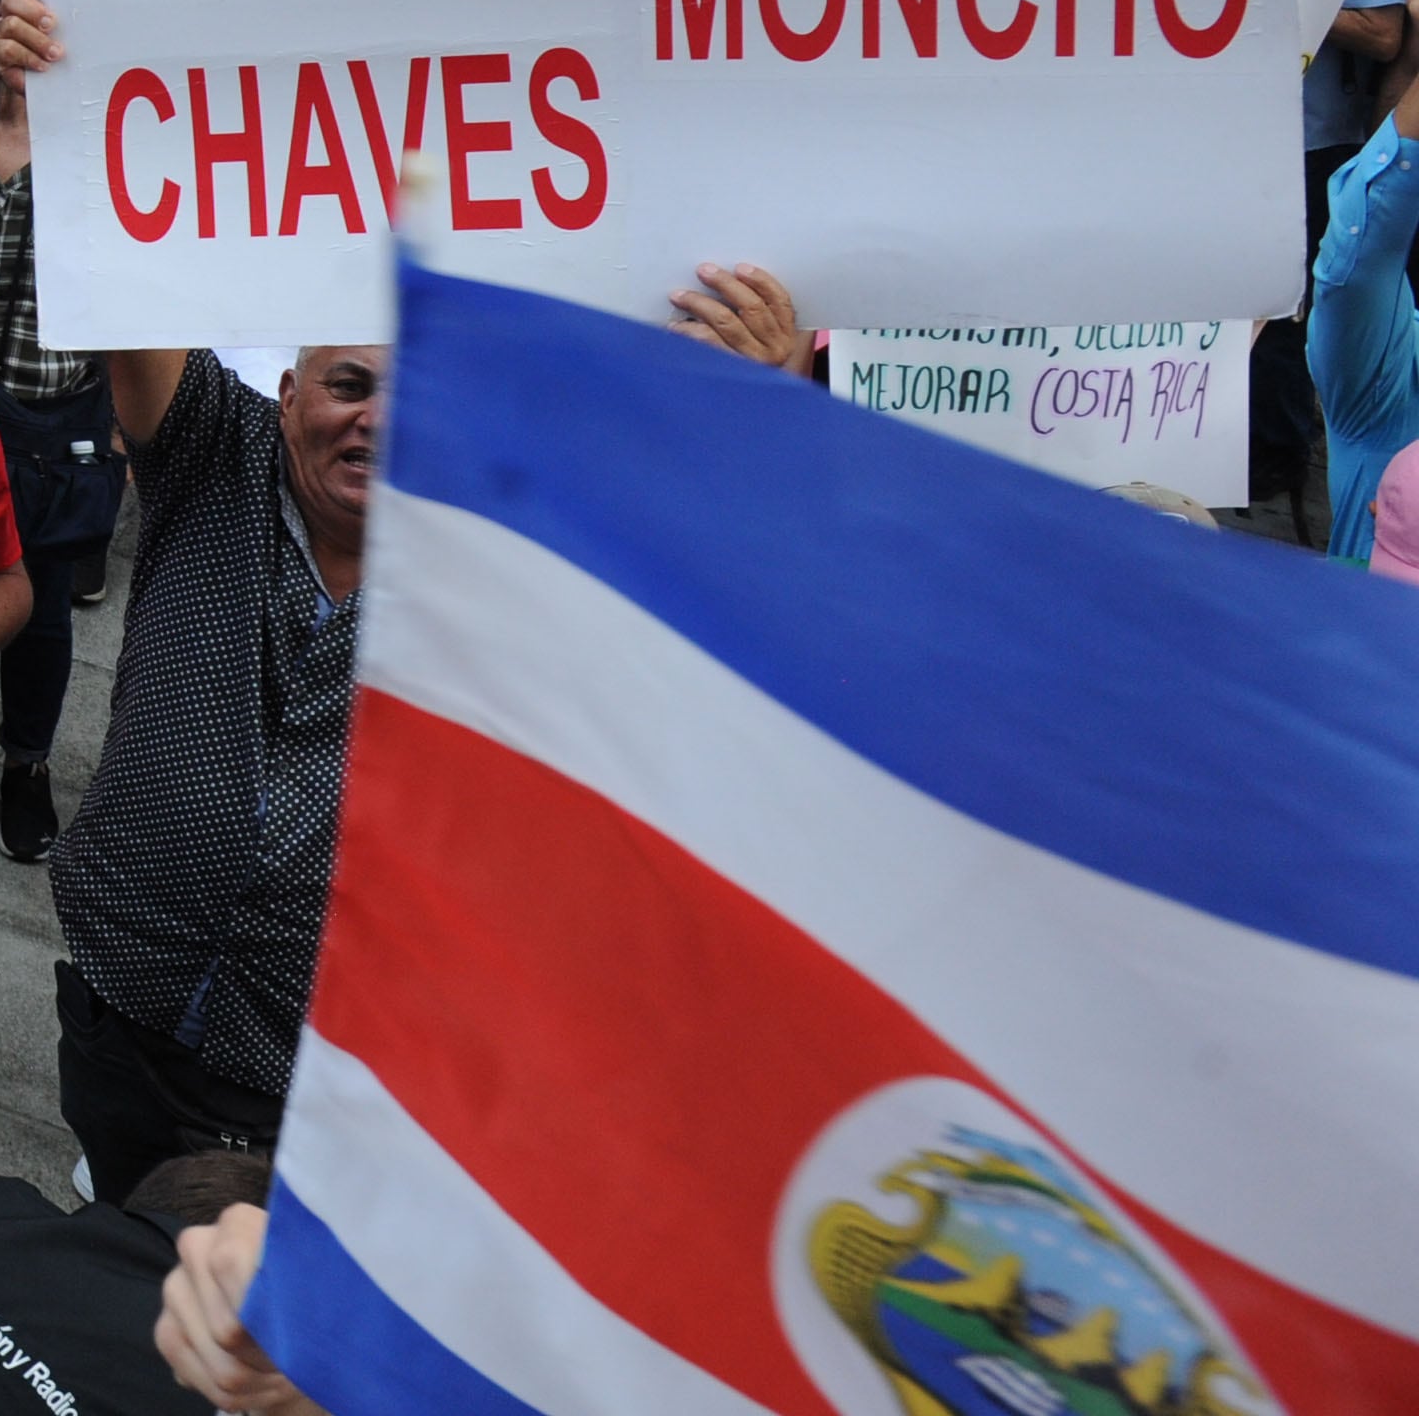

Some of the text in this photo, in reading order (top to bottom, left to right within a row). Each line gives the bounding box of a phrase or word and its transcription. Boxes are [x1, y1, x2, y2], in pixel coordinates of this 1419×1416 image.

[105, 47, 608, 243] CHAVES
[851, 359, 1211, 444] MEJORAR COSTA RICA
[2, 1348, 32, 1370] y
